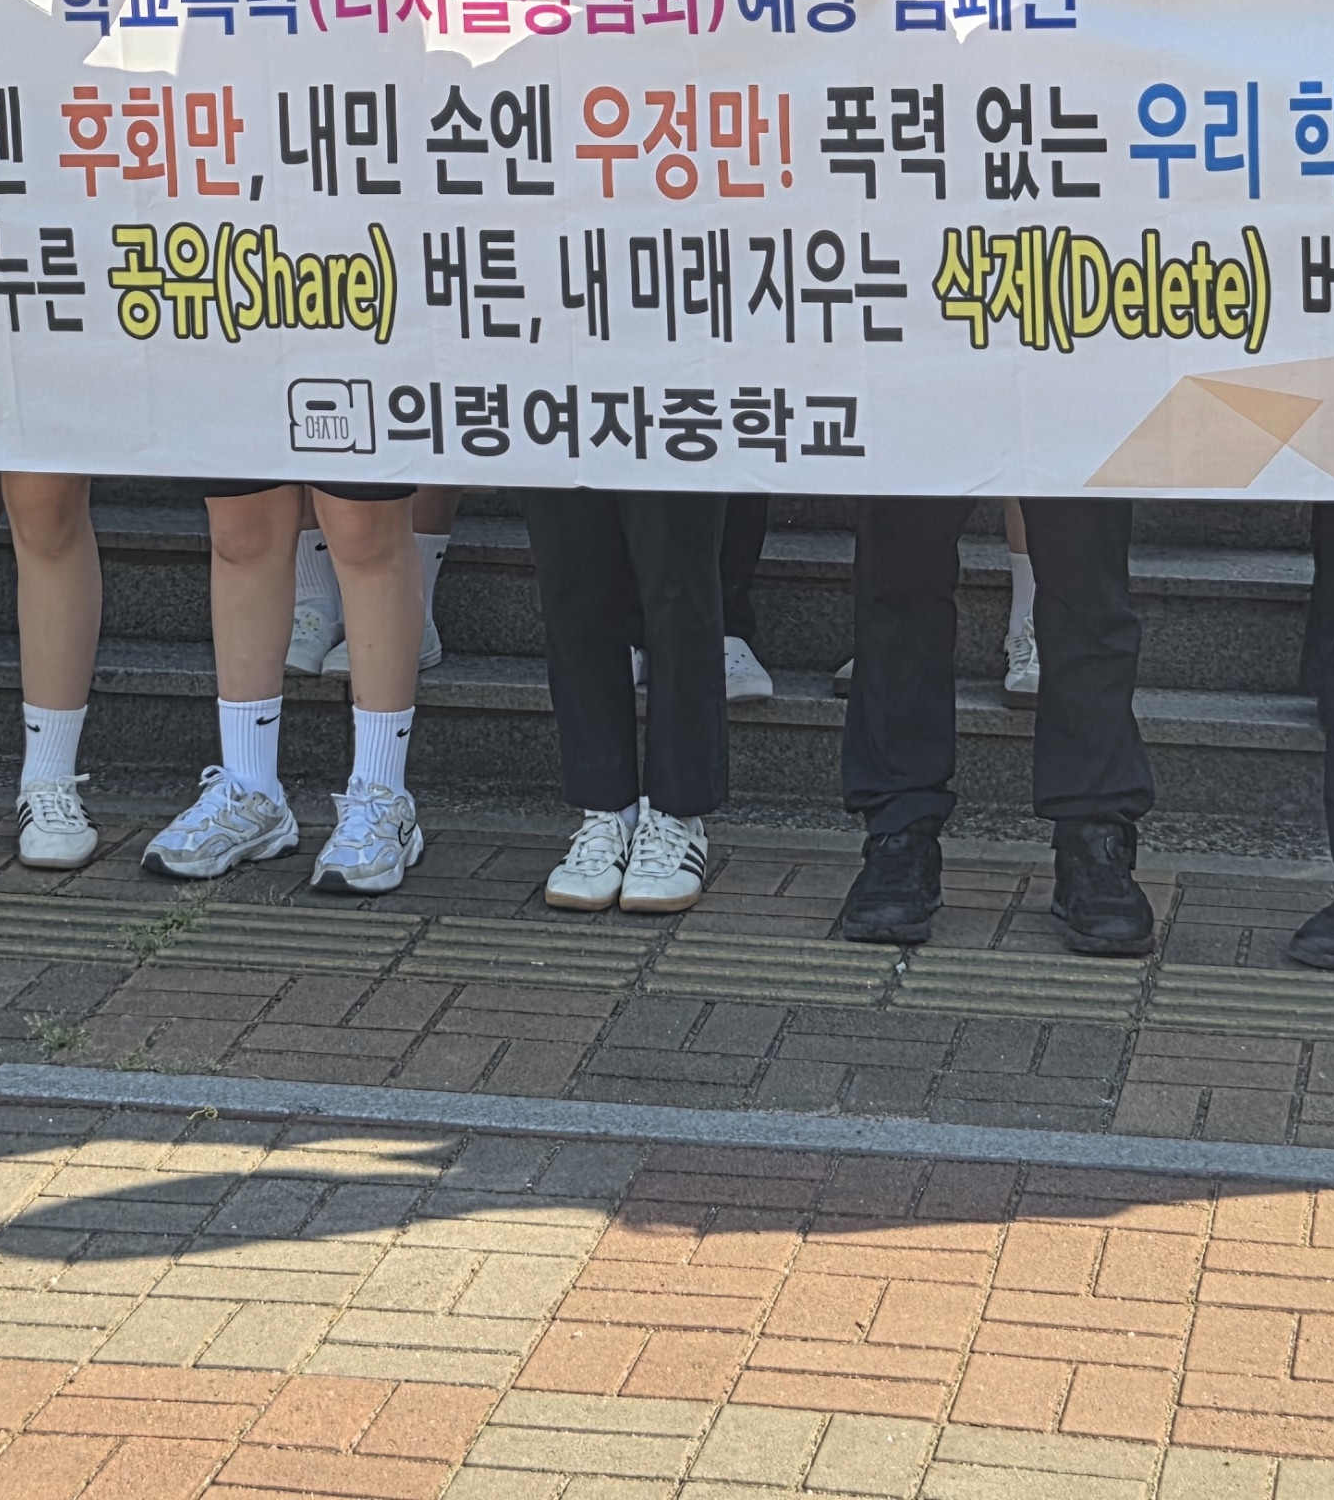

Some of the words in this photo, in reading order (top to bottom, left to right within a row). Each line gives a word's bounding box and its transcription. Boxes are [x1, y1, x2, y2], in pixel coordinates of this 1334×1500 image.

[58, 85, 265, 202] 후회만,
[278, 83, 402, 197] 내민
[425, 83, 556, 197] 손엔
[575, 83, 794, 201] 우정만!
[820, 83, 948, 201] 폭력
[976, 83, 1108, 202] 없는
[1129, 81, 1261, 201] 우리
[107, 221, 399, 344] 공유(Share)
[422, 226, 542, 345] 버튼,
[559, 227, 610, 342] 내
[628, 227, 734, 344] 미래
[747, 228, 909, 344] 지우는
[931, 225, 1272, 354] 삭제(Delete)
[387, 381, 866, 464] 의령여자중학교
